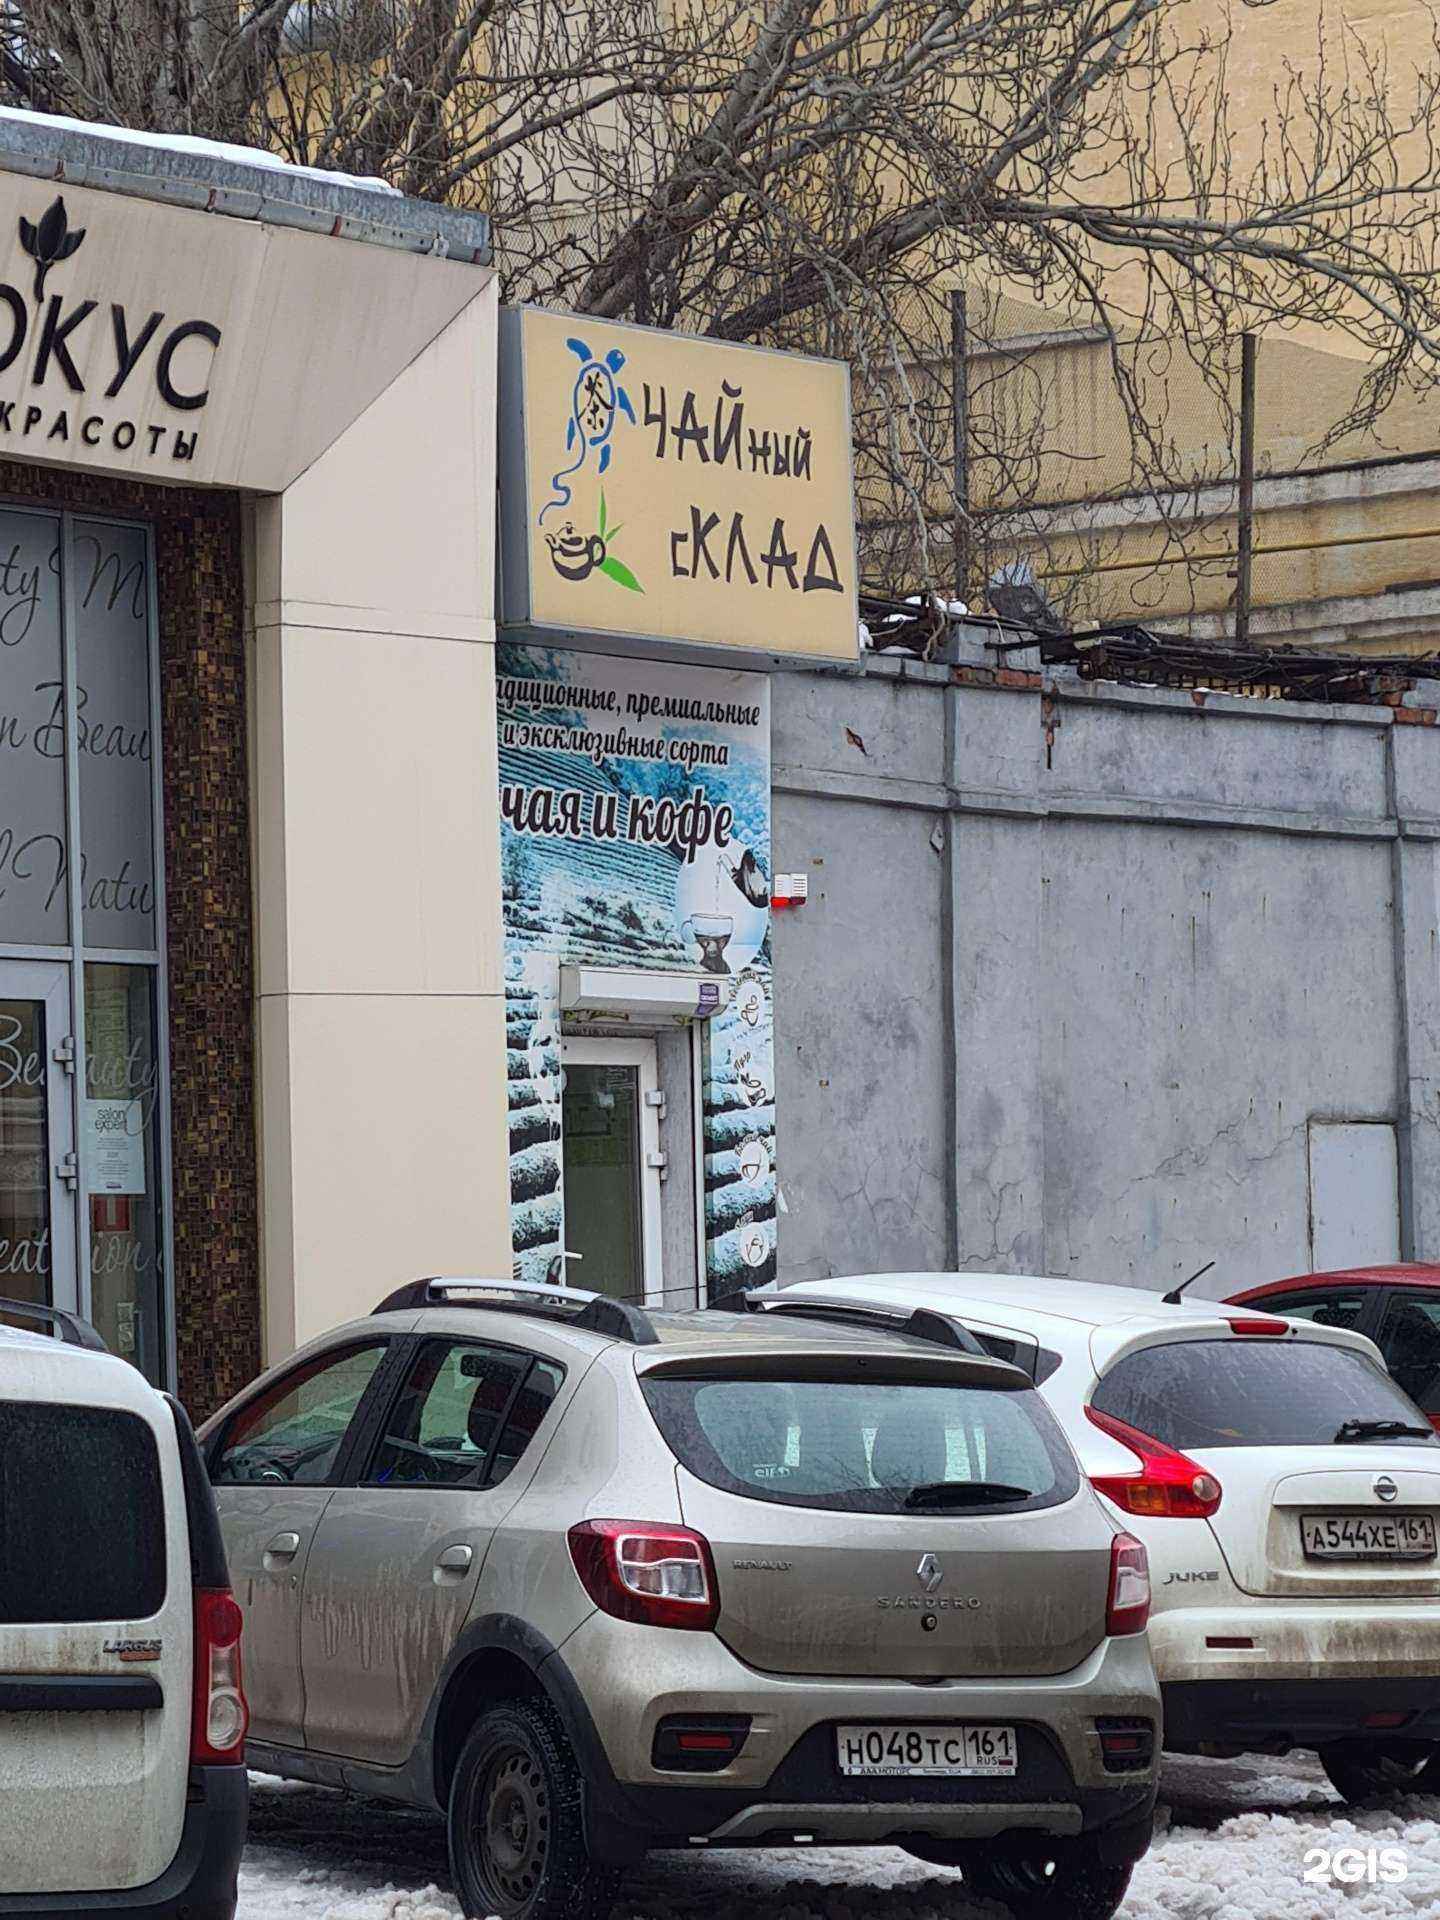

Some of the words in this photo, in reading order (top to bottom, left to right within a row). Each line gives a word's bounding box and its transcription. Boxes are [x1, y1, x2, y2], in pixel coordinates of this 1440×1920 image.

[0, 401, 198, 460] КРАСОТЫ
[642, 378, 812, 481] ЧАЙный
[670, 504, 845, 594] сКЛАД
[626, 692, 760, 726] премиальные
[503, 722, 515, 745] и
[519, 724, 664, 763] эксклюзивные
[670, 739, 729, 771] сорта
[501, 786, 582, 837] чая
[592, 794, 617, 839] и
[627, 788, 733, 864] кофе
[1398, 1520, 1428, 1541] 161
[733, 1559, 792, 1571] RENAULT
[1161, 1571, 1219, 1585] JUKE
[877, 1596, 982, 1609] SANDERO
[847, 1731, 961, 1765] Н048ТС
[968, 1730, 1009, 1756] 161
[977, 1756, 998, 1766] RUS
